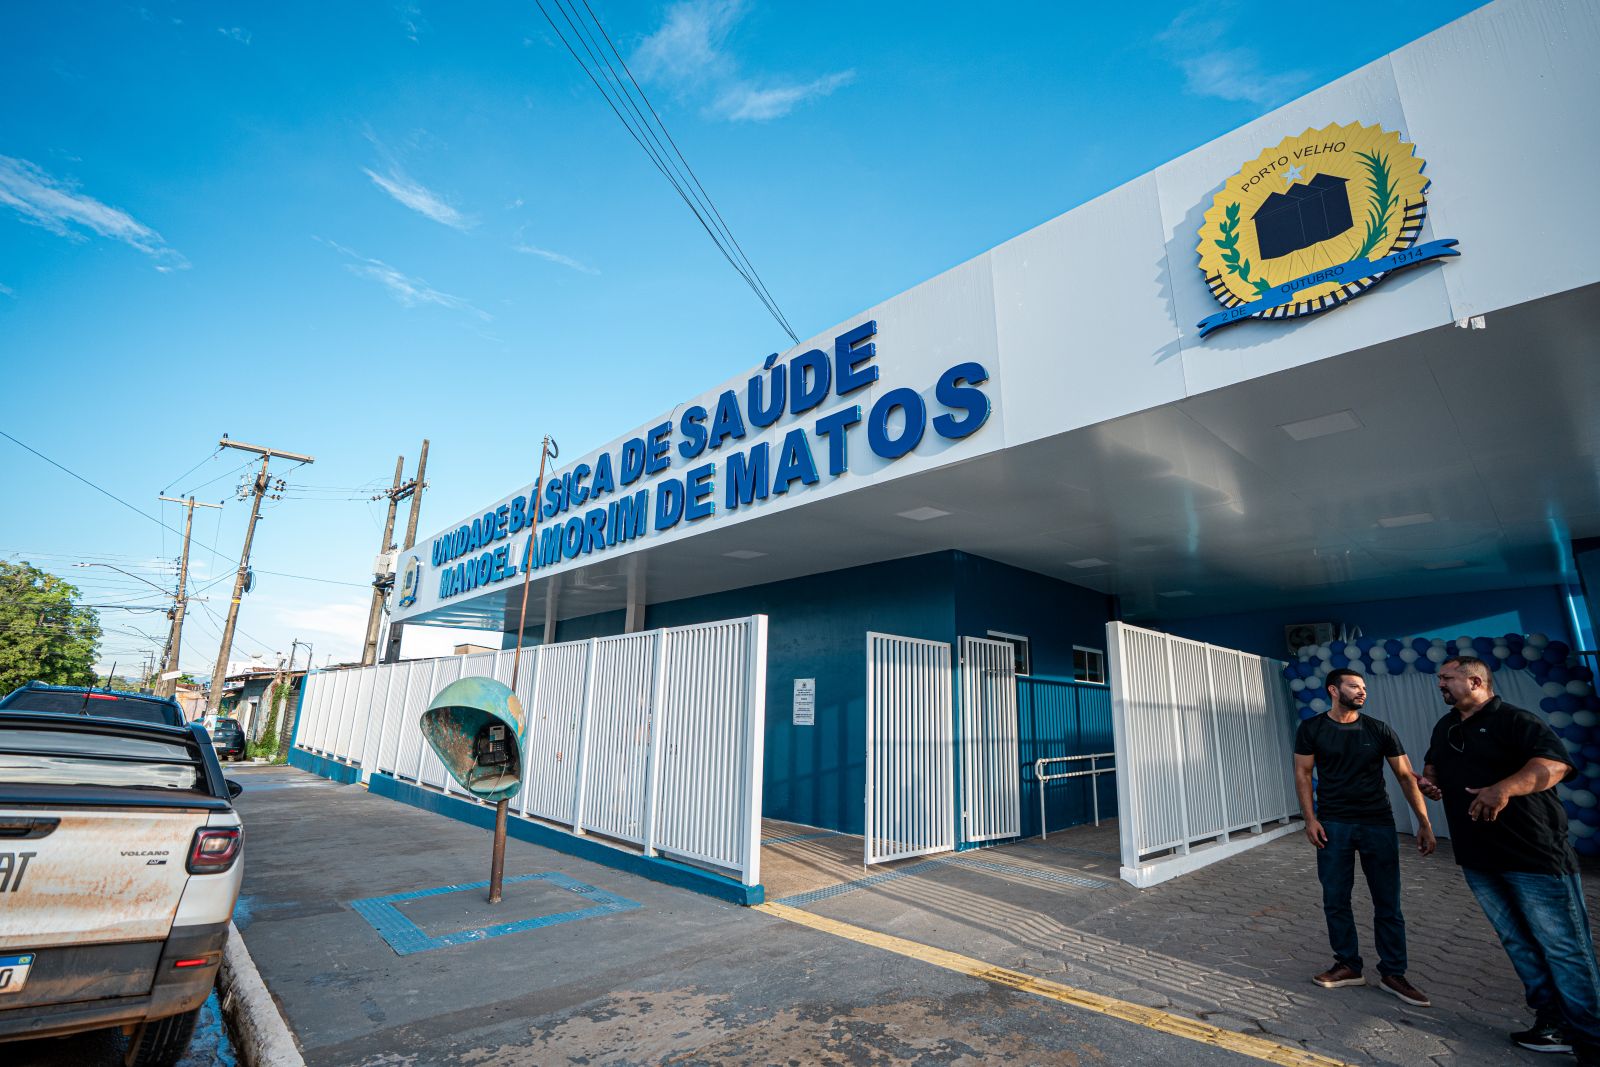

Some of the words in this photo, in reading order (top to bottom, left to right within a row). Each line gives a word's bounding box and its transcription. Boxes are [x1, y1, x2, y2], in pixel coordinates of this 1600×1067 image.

[1241, 156, 1289, 193] PORTO
[1293, 141, 1346, 160] VELHO
[1221, 311, 1230, 322] 2
[1231, 306, 1248, 318] DE
[1281, 266, 1344, 293] OUTUBRO
[1391, 248, 1424, 265] 1914
[432, 504, 509, 567] UNIDADE
[509, 452, 614, 534] BÁSICA
[620, 420, 673, 486] DE
[678, 320, 879, 459] SAÚDE
[439, 543, 517, 599] MANOEL
[520, 488, 650, 573] AMORIM
[655, 463, 716, 531] DE
[725, 362, 992, 509] MATOS
